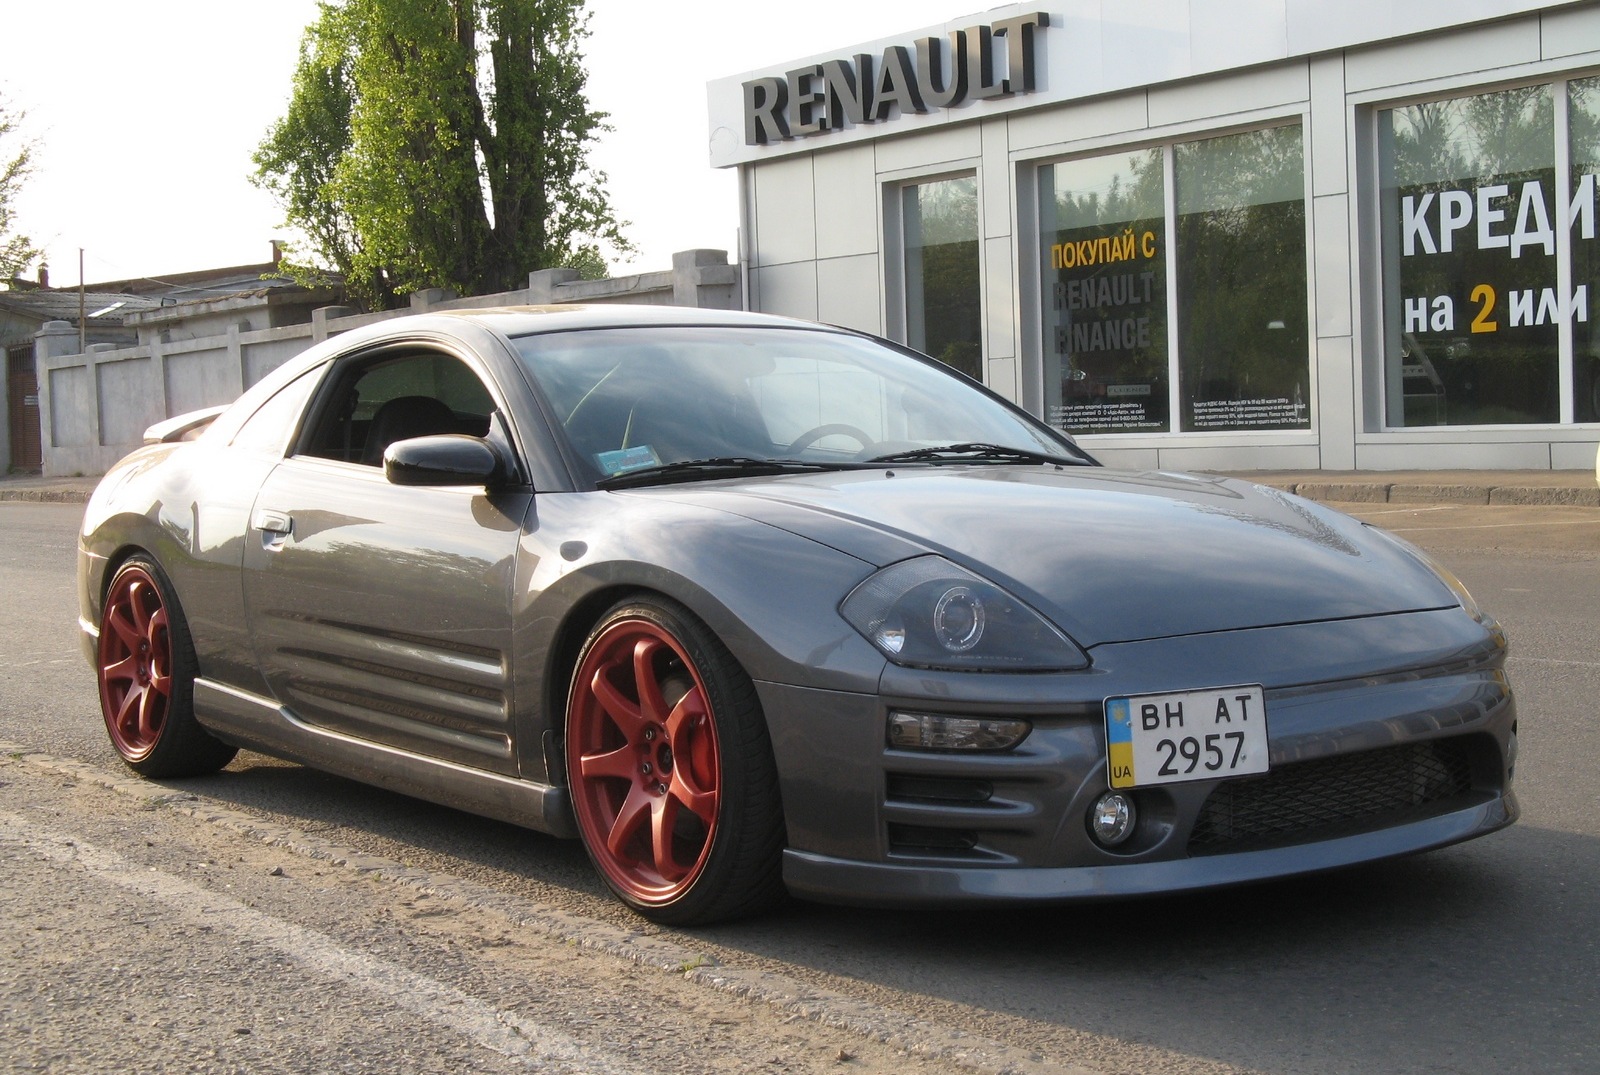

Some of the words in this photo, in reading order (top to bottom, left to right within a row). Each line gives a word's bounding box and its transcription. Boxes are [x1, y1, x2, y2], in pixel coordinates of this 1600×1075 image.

[742, 12, 1049, 146] RENAULT
[1051, 228, 1136, 270] ПОКУПАЙ
[1141, 231, 1155, 258] С
[1053, 271, 1155, 311] RENAULT
[1405, 295, 1454, 333] на
[1470, 284, 1497, 333] 2
[1054, 317, 1151, 354] FINANCE
[1141, 701, 1184, 731] BH
[1215, 695, 1252, 724] AT
[1113, 766, 1132, 779] UA
[1156, 731, 1245, 776] 2957
